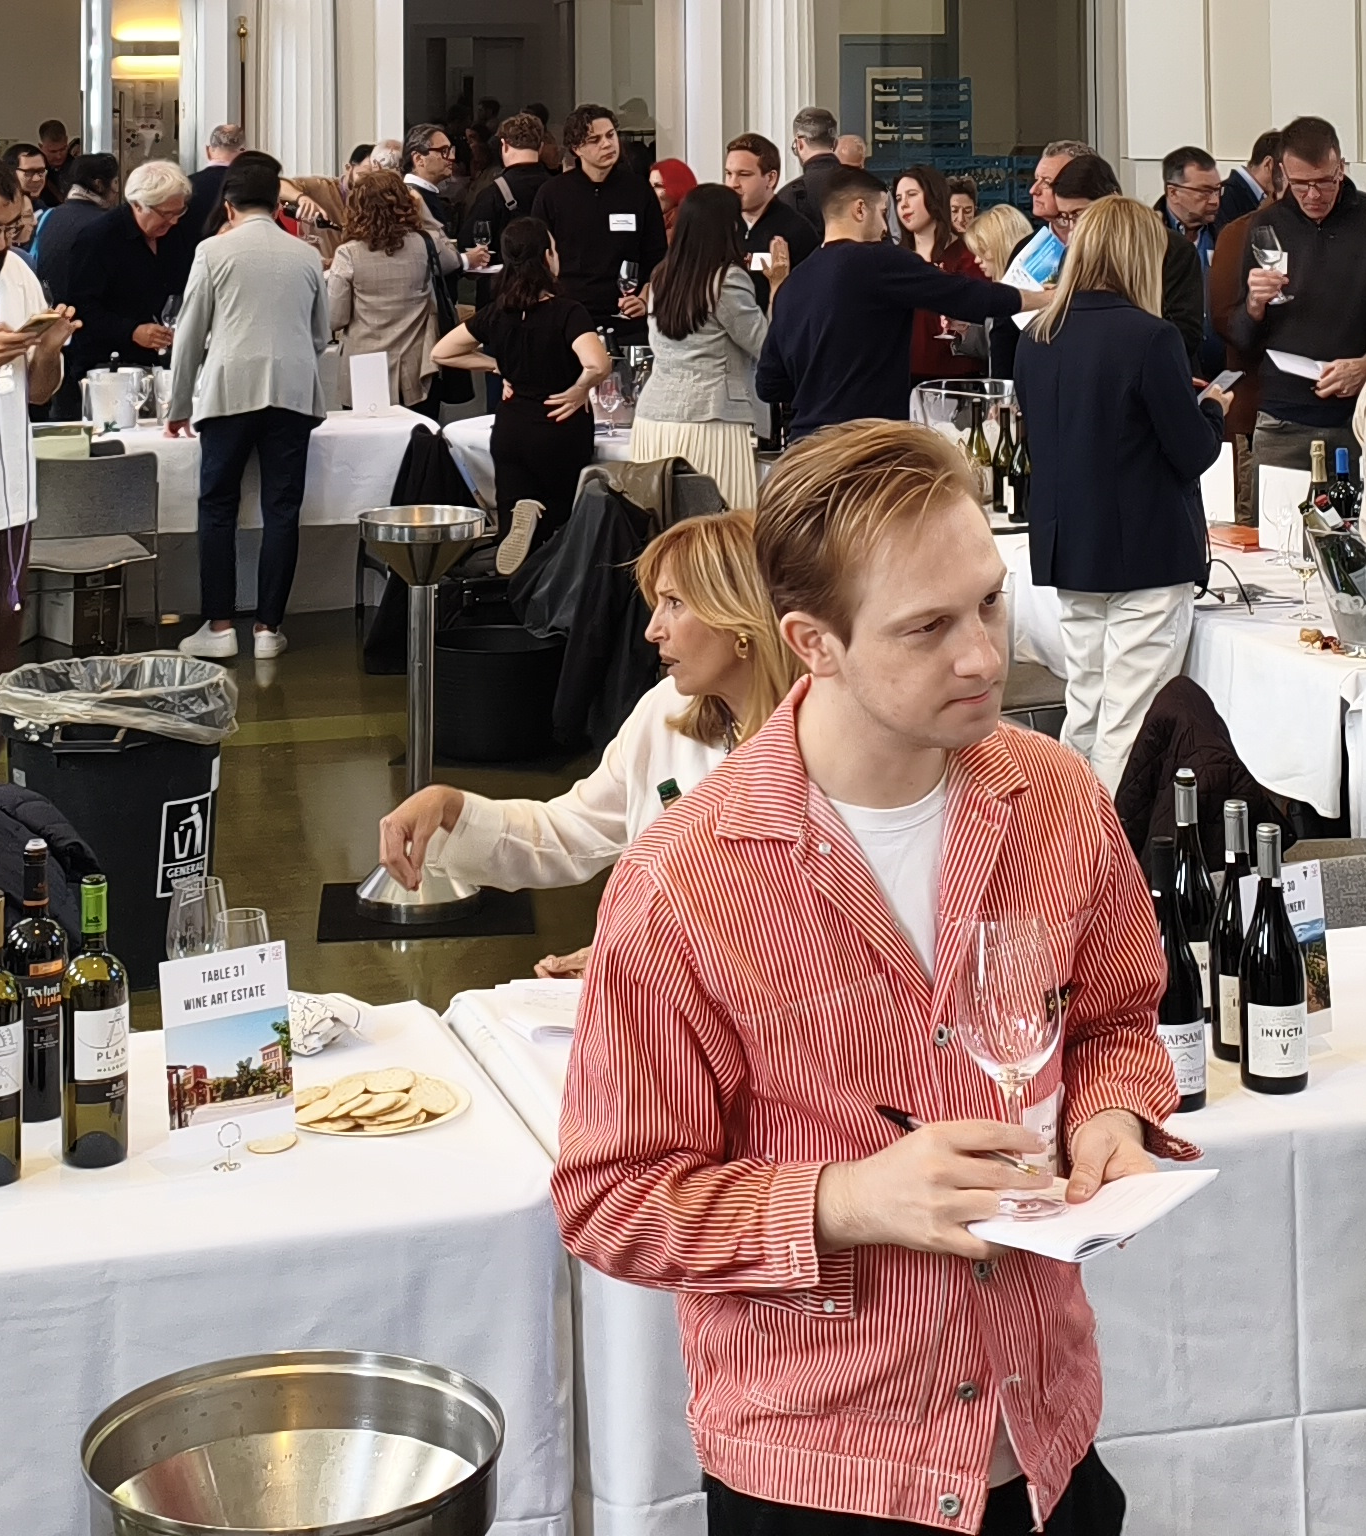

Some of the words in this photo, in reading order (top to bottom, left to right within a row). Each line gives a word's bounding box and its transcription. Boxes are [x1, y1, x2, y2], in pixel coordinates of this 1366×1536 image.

[166, 861, 204, 879] GENERAL
[202, 967, 231, 984] TABLE
[233, 964, 245, 978] 31
[184, 995, 208, 1011] WINE
[211, 991, 229, 1006] ART
[232, 984, 266, 1002] ESTATE
[1261, 1026, 1303, 1038] INVICTA
[1280, 1042, 1290, 1056] V
